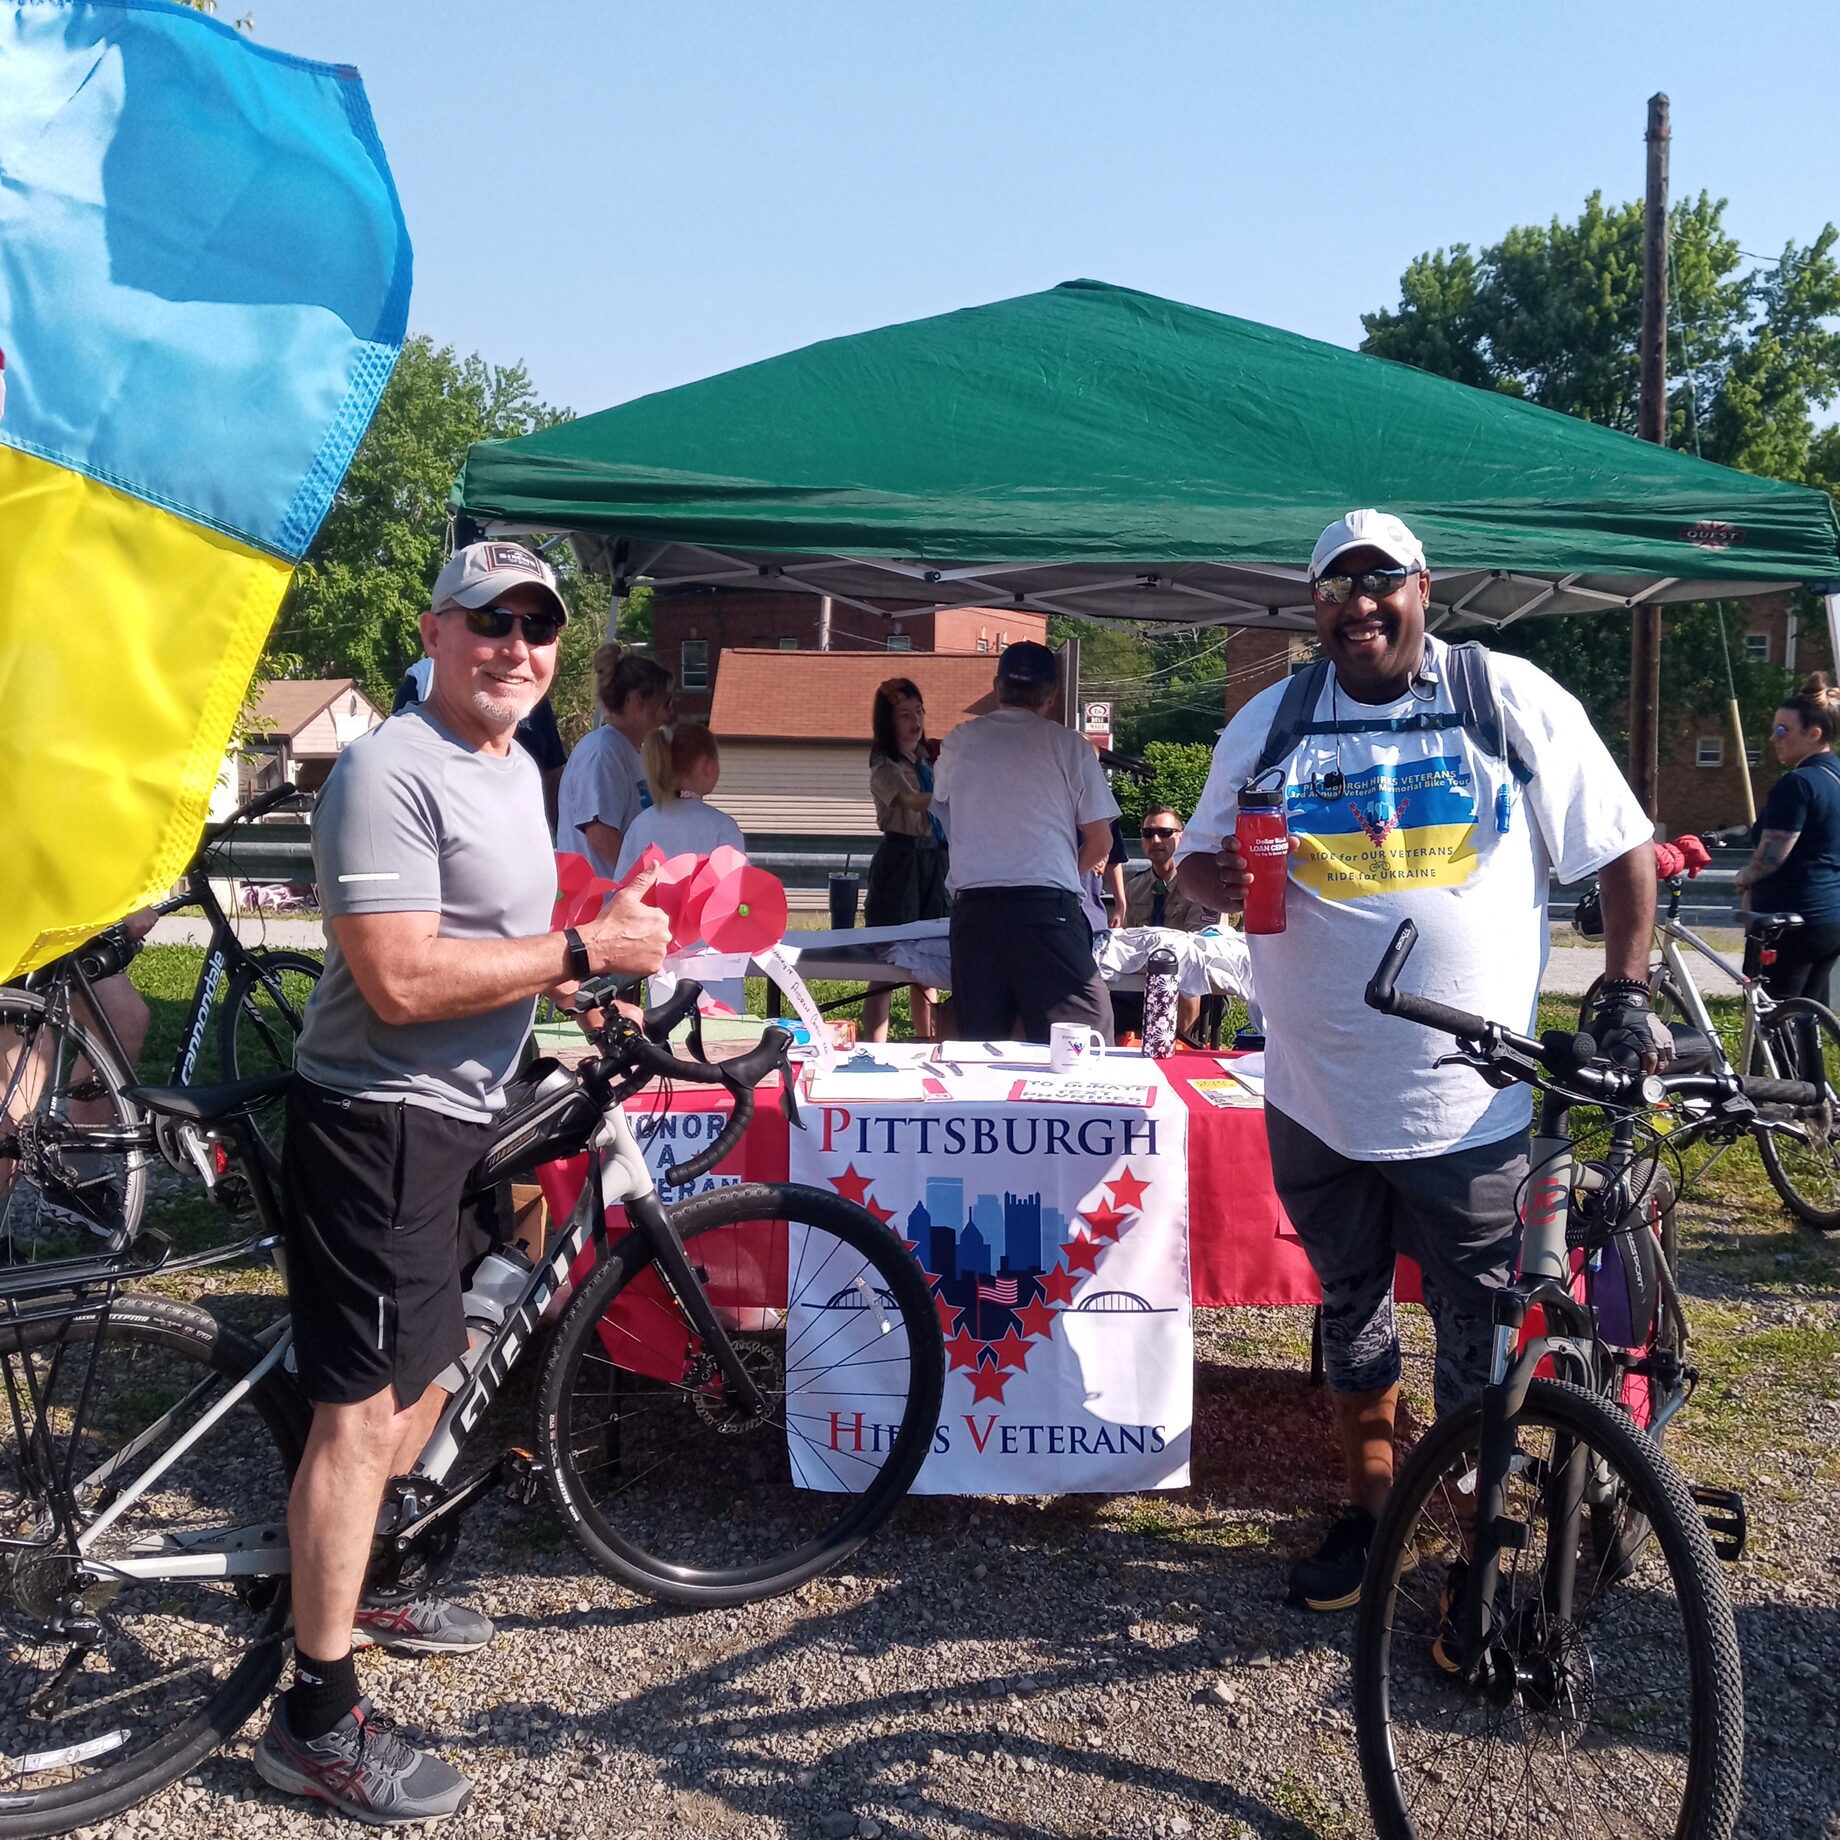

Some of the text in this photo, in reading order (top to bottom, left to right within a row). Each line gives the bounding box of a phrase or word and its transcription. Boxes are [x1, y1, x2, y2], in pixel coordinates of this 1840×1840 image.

[1344, 786, 1376, 797] Veteran
[1424, 779, 1445, 788] Bike
[1447, 777, 1469, 787] Tour
[1401, 770, 1456, 785] VETERANS
[1310, 846, 1454, 861] RIDE for OUR VETERANS
[1327, 868, 1437, 882] RIDE for UKRAINE
[181, 950, 226, 1087] cannondale
[628, 1114, 726, 1139] ONOR
[818, 1107, 1161, 1156] PITTSBURGH
[961, 1414, 1166, 1455] VETERANS
